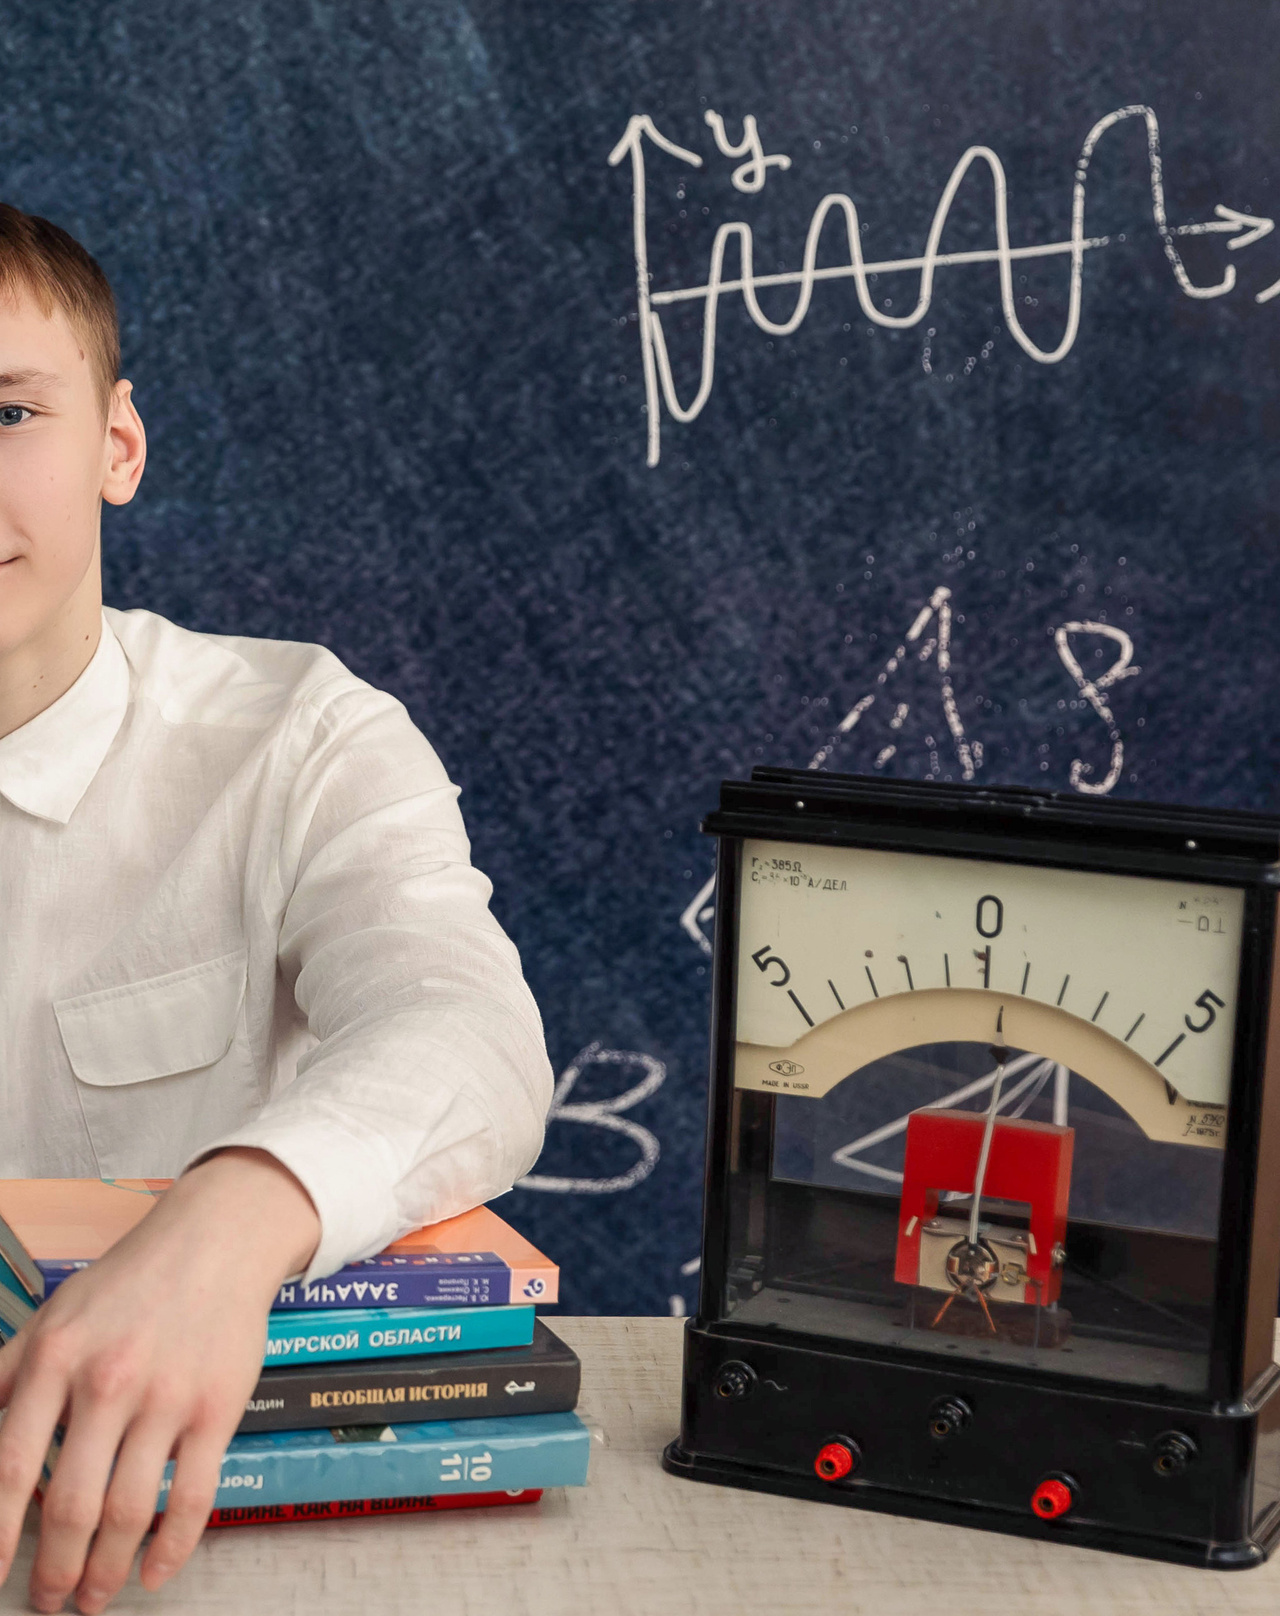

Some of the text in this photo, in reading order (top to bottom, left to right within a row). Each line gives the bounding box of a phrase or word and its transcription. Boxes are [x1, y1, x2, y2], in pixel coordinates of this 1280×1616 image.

[975, 895, 1004, 939] 0
[751, 944, 791, 988] 5
[1183, 988, 1227, 1034] 5
[761, 1079, 780, 1088] MADE
[792, 1081, 810, 1090] USSR
[280, 1281, 399, 1304] ЗАДАЧИ Н
[267, 1325, 462, 1356] МУРСКОЙ ОБЛАСТИ
[245, 1382, 489, 1412] адин ВСЕОБЩАЯ ИСТОРИЯ
[220, 1473, 264, 1490] Геог
[439, 1453, 462, 1482] 11
[471, 1451, 493, 1482] 10
[293, 1500, 333, 1517] КАК
[339, 1498, 364, 1514] НА
